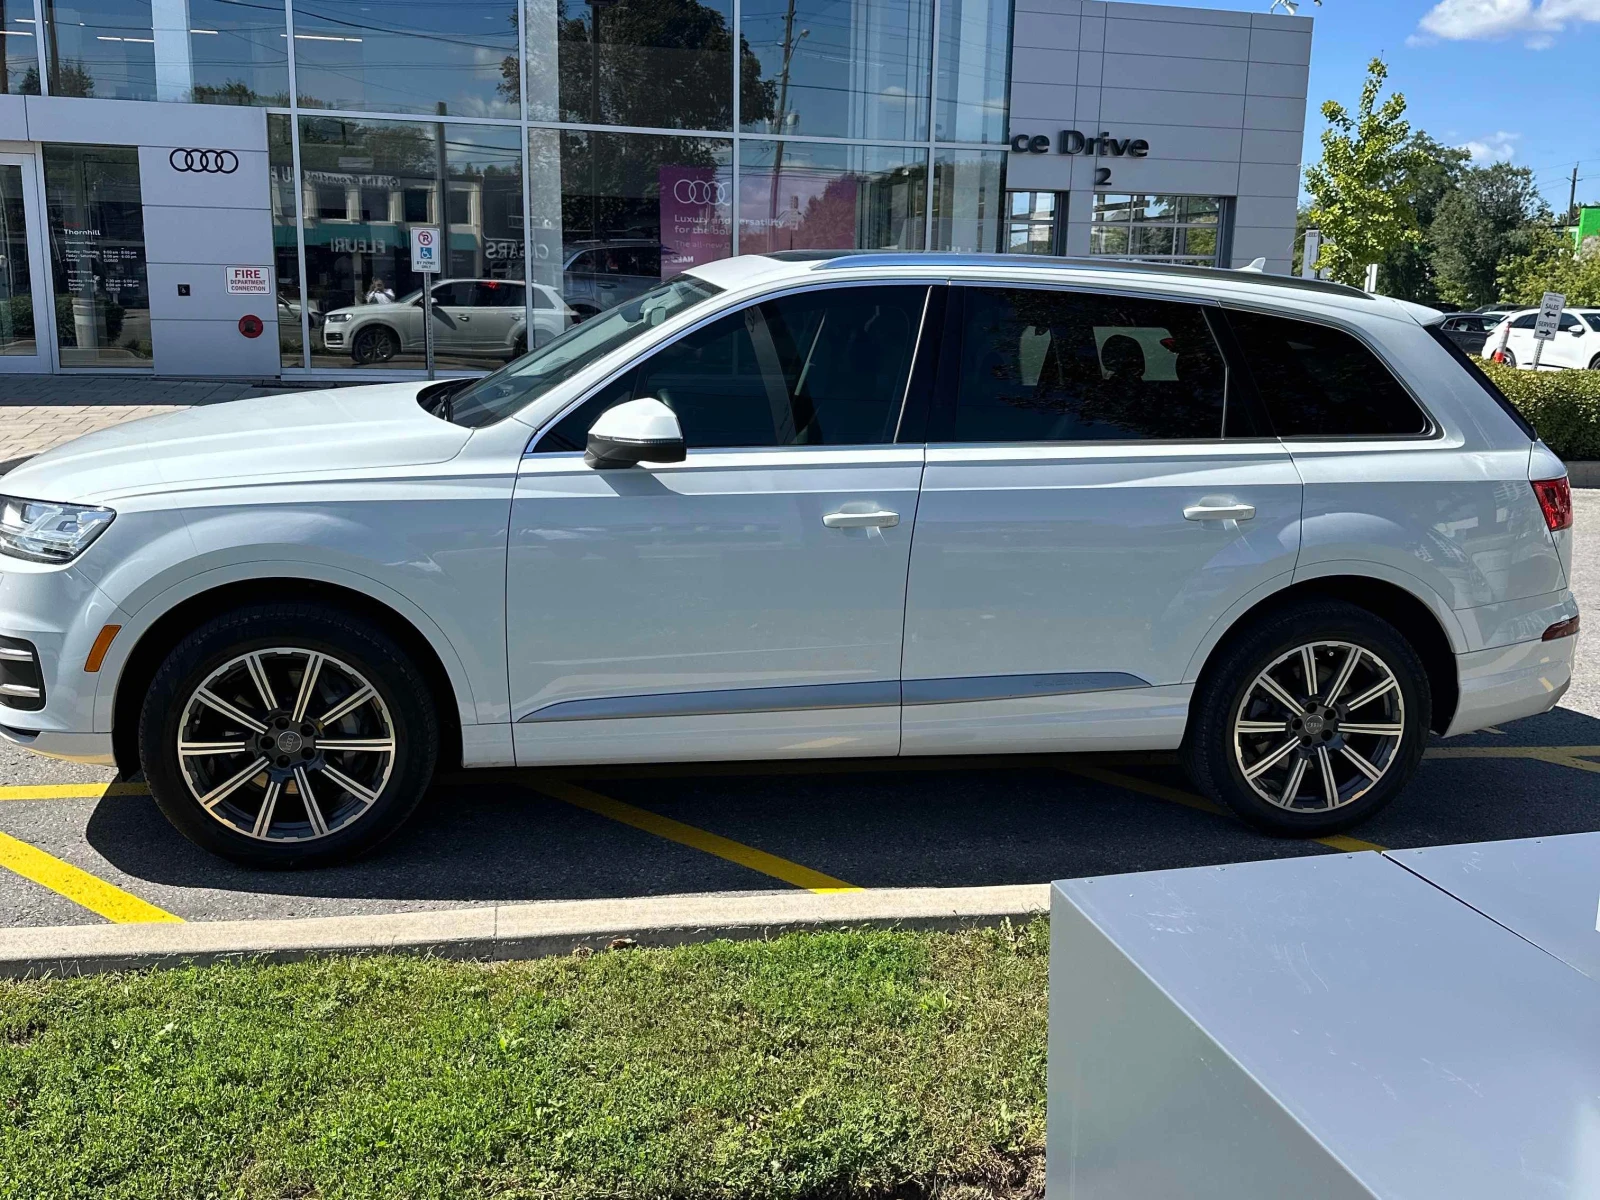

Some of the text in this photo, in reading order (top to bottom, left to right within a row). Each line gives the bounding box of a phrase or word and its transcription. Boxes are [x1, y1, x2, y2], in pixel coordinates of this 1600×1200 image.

[1060, 129, 1150, 158] Drive
[1095, 167, 1112, 186] 2
[674, 214, 708, 225] Luxury
[738, 219, 785, 228] ersatility
[675, 225, 690, 233] for
[234, 269, 261, 279] FIRE
